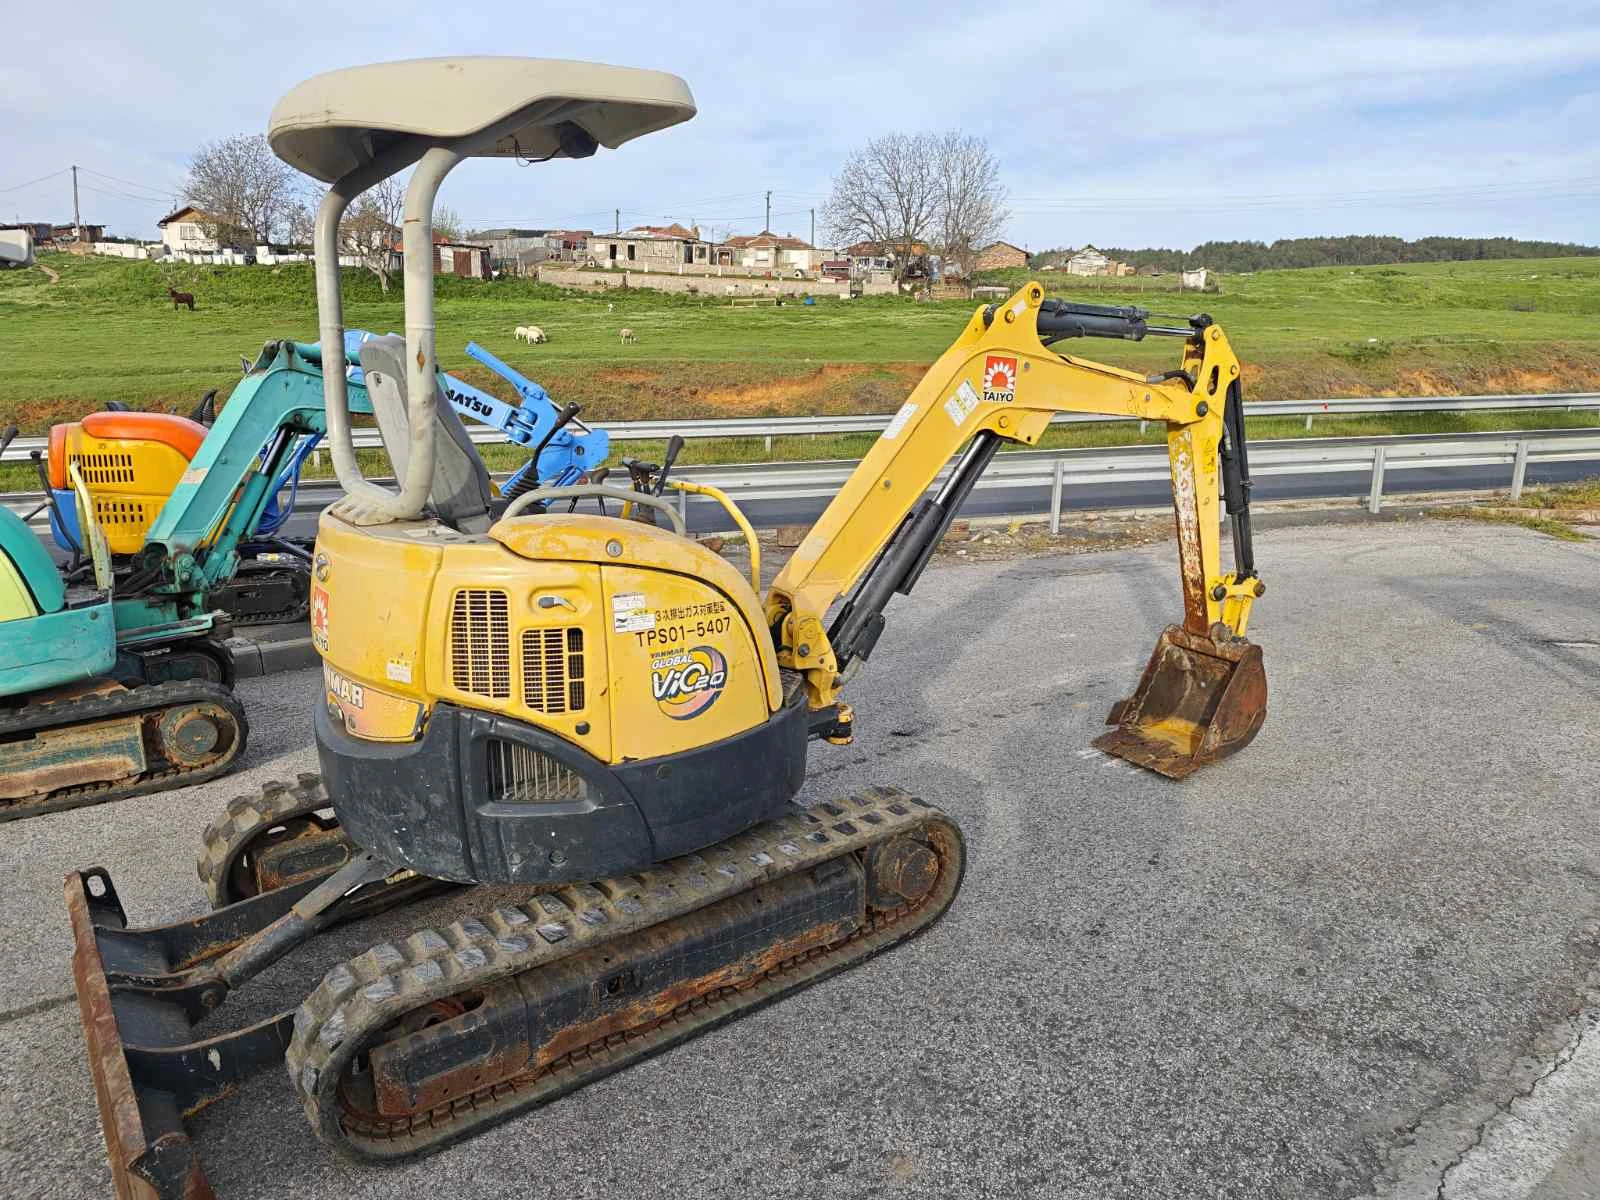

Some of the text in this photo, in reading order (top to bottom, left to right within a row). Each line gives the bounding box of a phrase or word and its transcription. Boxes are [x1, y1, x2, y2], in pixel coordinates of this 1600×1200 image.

[983, 391, 1014, 402] TAIYO
[635, 616, 731, 648] TPS01-5407
[652, 655, 694, 670] GLOBAL
